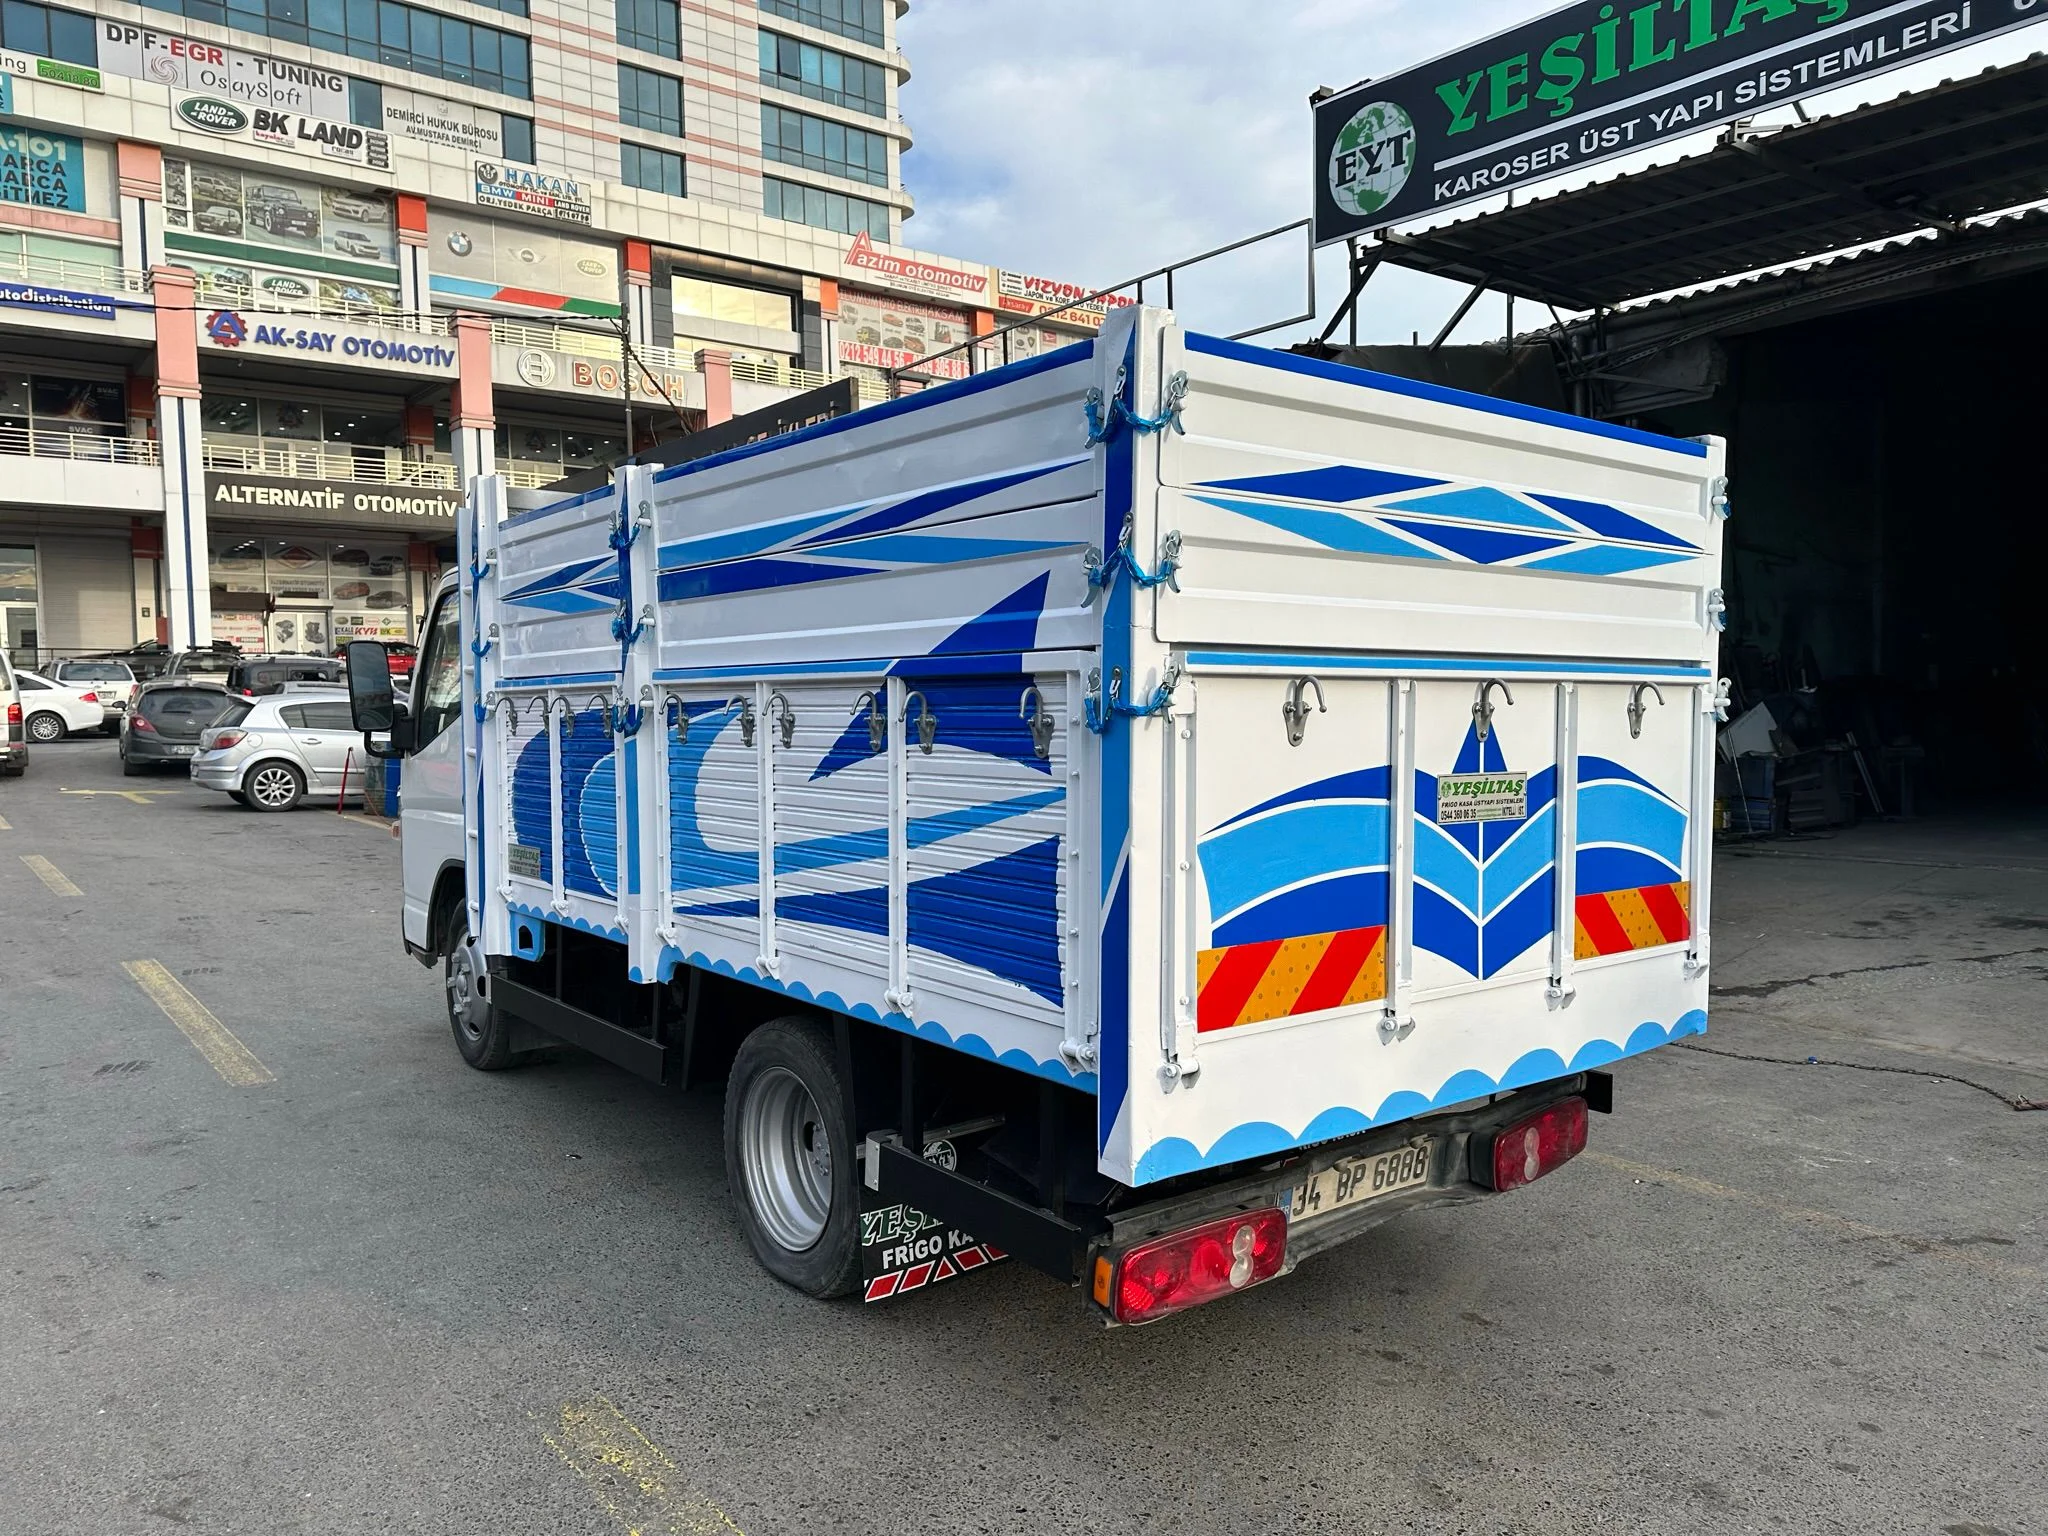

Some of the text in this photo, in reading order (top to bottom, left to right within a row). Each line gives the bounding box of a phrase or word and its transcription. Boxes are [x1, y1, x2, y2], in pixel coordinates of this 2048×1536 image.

[253, 58, 343, 92] TUNING
[194, 101, 229, 116] LAND
[1434, 2, 1971, 201] KAROSER ÜST YAPI SİSTEMLERİ
[198, 110, 237, 127] ROVER
[253, 108, 363, 149] BK LAND
[386, 107, 498, 141] DEMİRCİ HUKUK BÜROSU
[3, 153, 67, 177] ARCA
[1335, 130, 1411, 188] EYT
[0, 168, 68, 193] ARCA
[505, 167, 578, 196] HAKAN
[481, 185, 590, 213] BMW MINI LAND ROVER
[526, 204, 553, 218] PARÇA
[271, 279, 295, 288] LAND
[857, 253, 984, 290] azim otomotiv
[1023, 289, 1044, 300] JAPON
[1069, 311, 1090, 325] 641
[254, 324, 455, 368] AK-SAY OTOMOTİV
[572, 361, 685, 400] BOSCH
[215, 485, 457, 518] ALTERNATİF OTOMOTİV
[1452, 777, 1524, 798] YEŞİLTAŞ
[1292, 1146, 1428, 1217] 34 BP 6888
